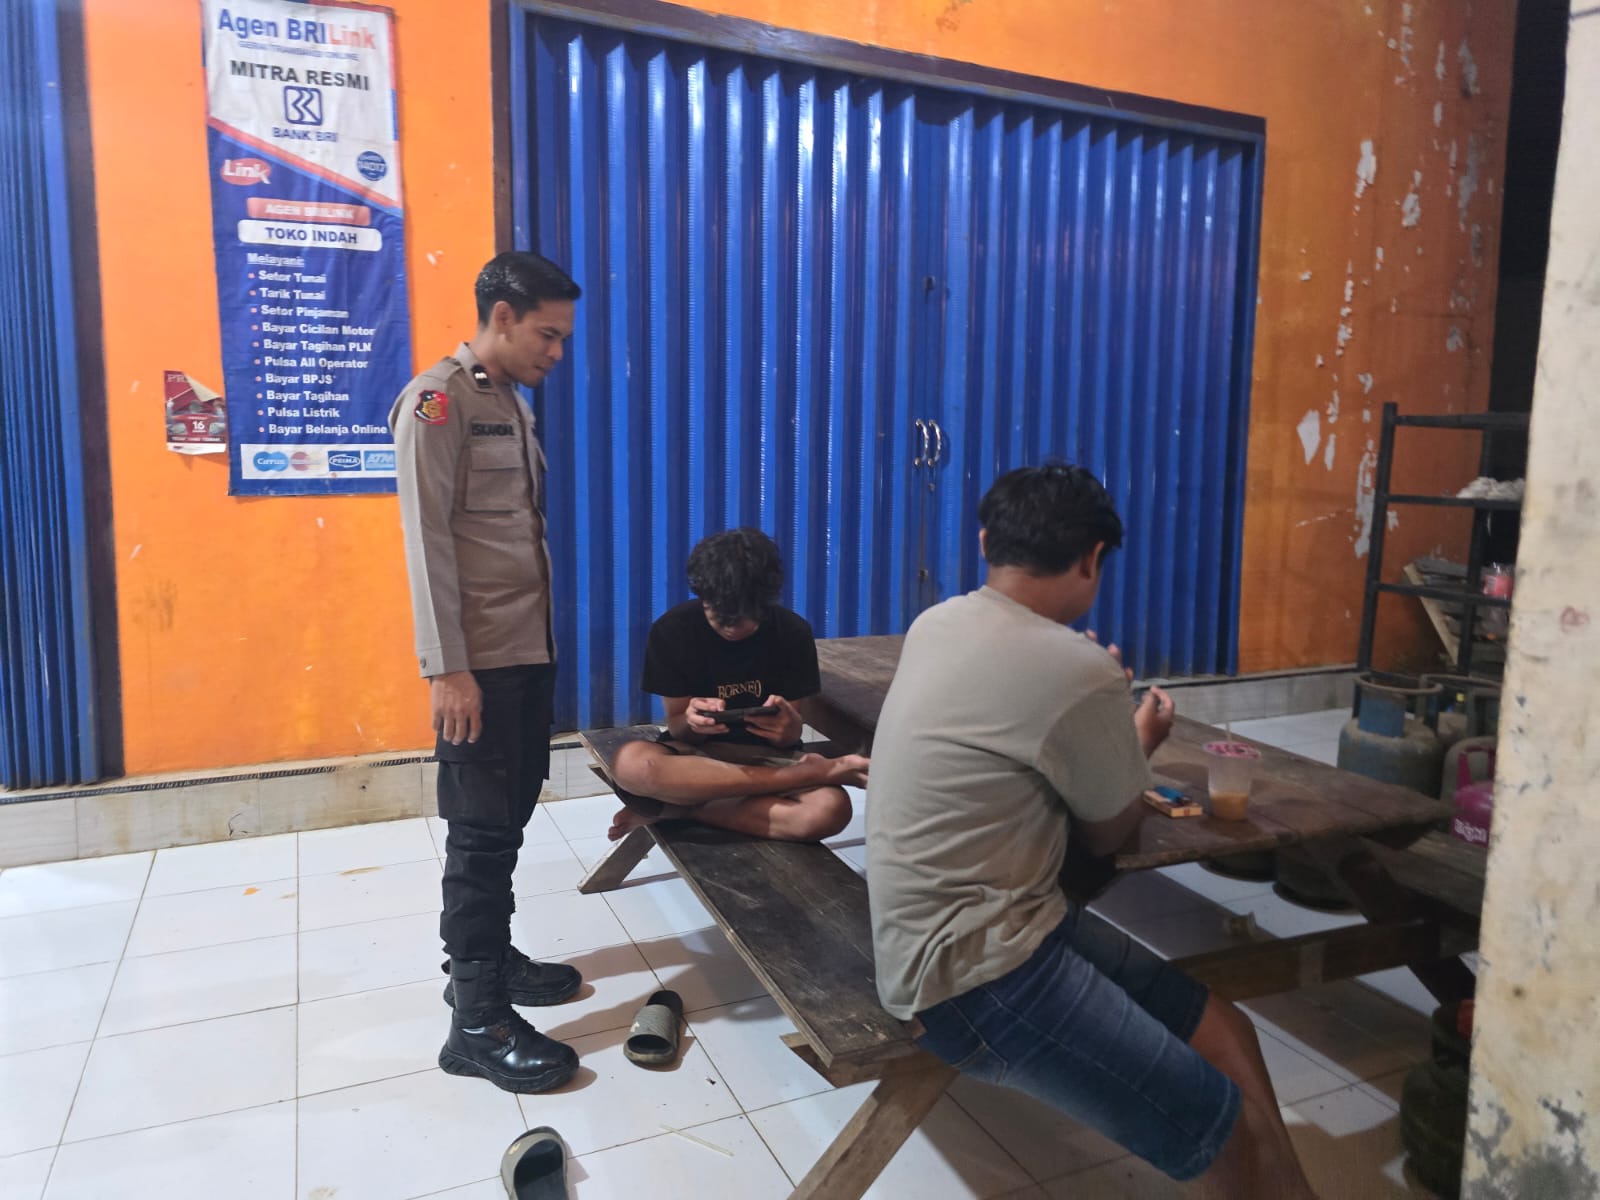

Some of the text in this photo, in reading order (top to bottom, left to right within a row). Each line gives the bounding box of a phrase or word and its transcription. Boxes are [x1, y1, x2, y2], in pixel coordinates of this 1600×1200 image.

[219, 8, 279, 39] Agen
[287, 18, 376, 49] BRILink
[230, 60, 370, 91] MITRA RESMI
[272, 127, 338, 142] BANK BRI
[222, 159, 271, 185] Link
[264, 227, 358, 244] TOKO INDAH
[258, 270, 291, 282] Setor
[259, 287, 290, 299] Tarik
[261, 304, 293, 316] Setor
[262, 322, 376, 336] Bayar Cicilan Motor
[263, 339, 372, 353] Bayar Tagihan PLN
[264, 356, 368, 370] Pulsa All Operator
[265, 373, 333, 385] Bayar BPJS
[266, 390, 349, 403] Bayar Tagihan
[267, 407, 340, 418] Pulsa Listrik
[268, 424, 388, 436] Bayar Belanja Online
